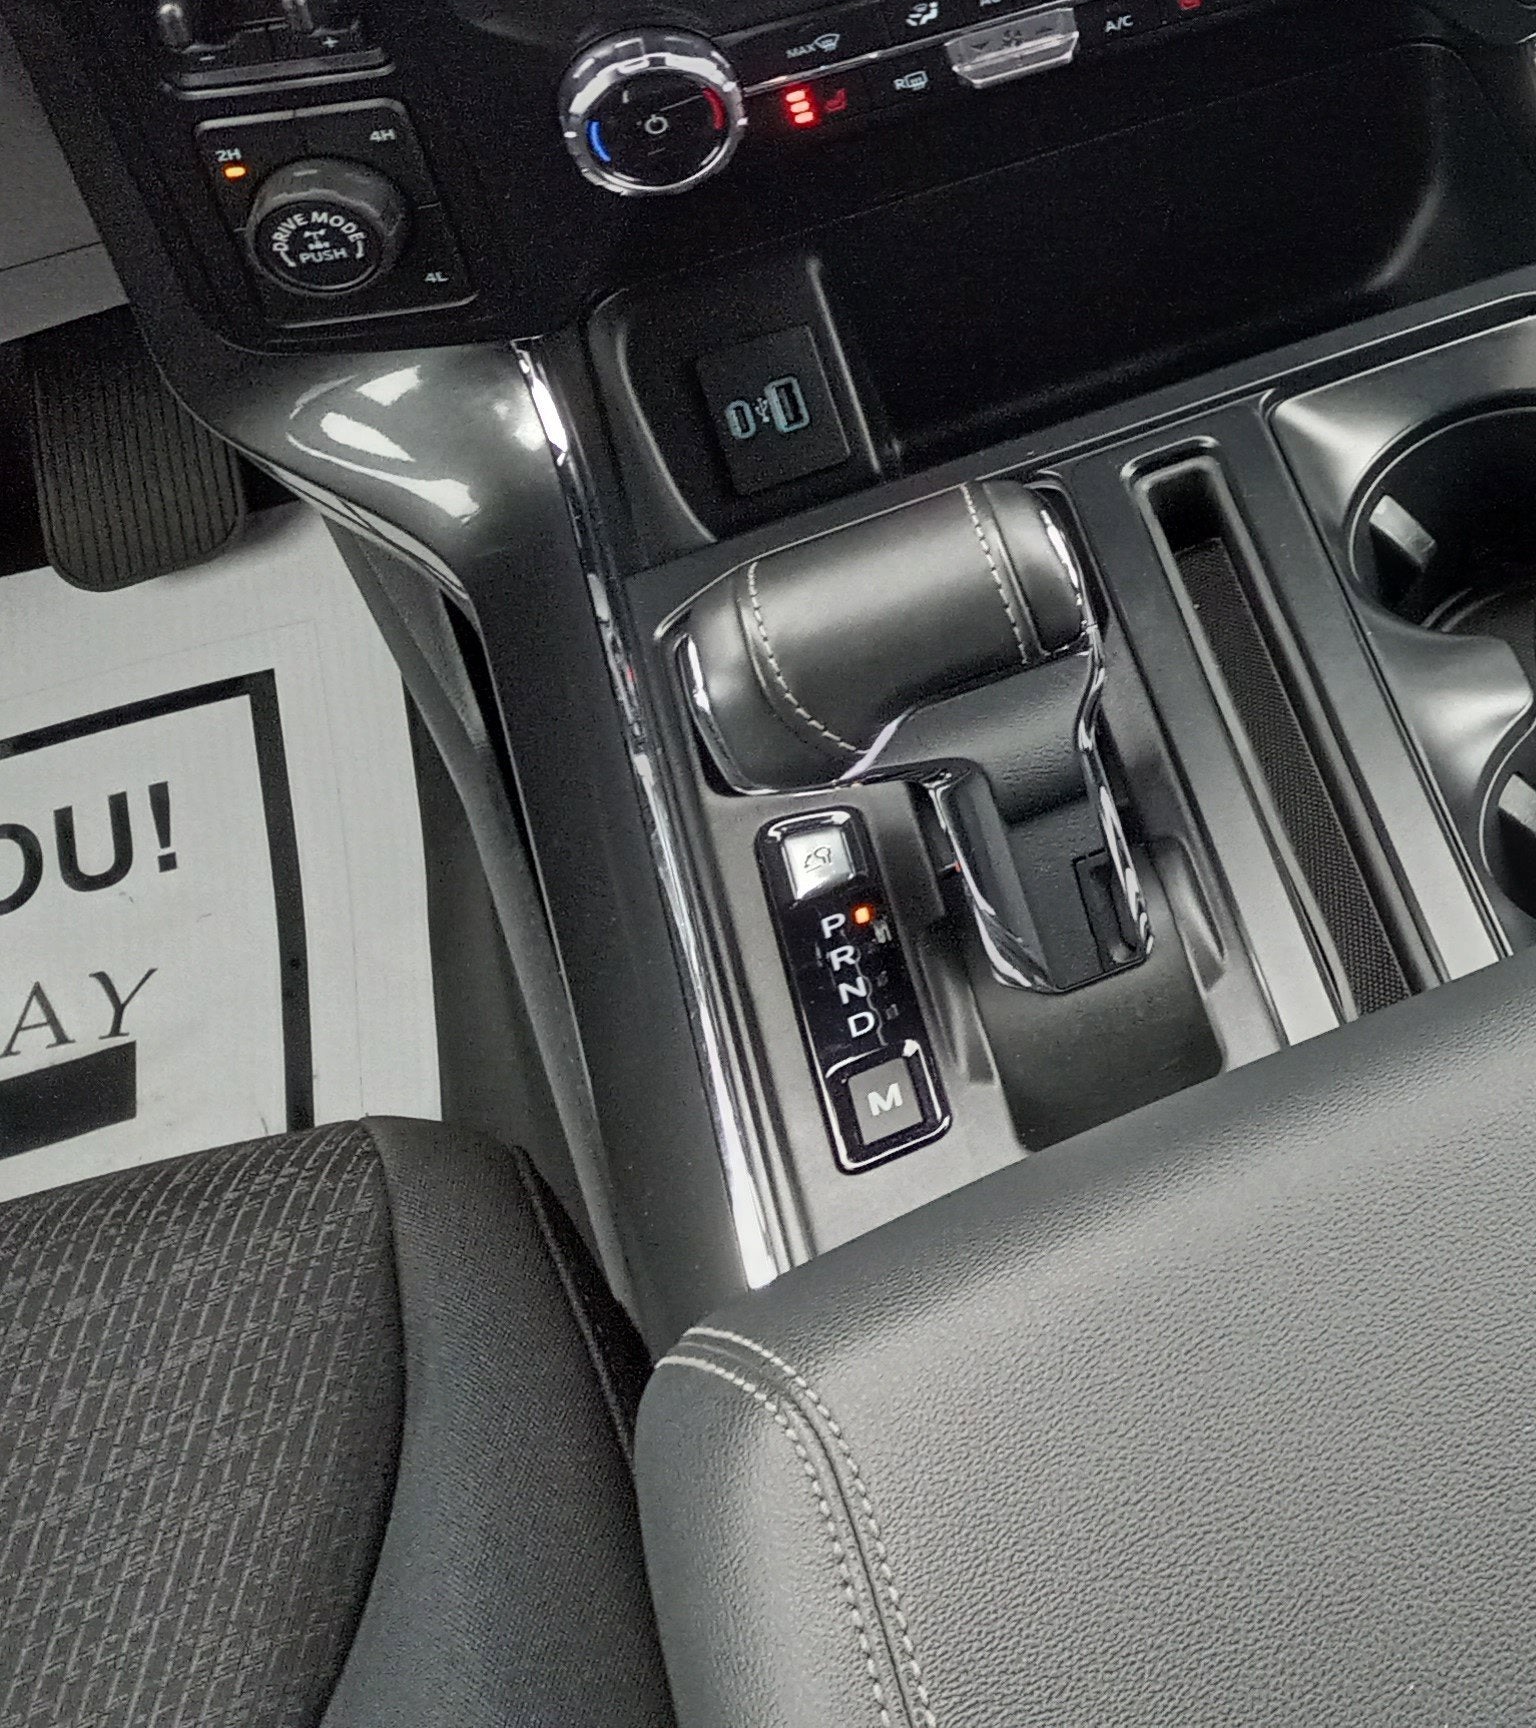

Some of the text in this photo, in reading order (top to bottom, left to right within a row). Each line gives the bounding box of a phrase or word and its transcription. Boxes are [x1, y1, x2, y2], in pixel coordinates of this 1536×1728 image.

[1104, 14, 1134, 34] A/C
[785, 42, 816, 59] MAX
[369, 128, 397, 143] 4H
[215, 147, 242, 162] 2H
[272, 209, 368, 254] DRIVE MODE
[299, 247, 349, 265] PUSH
[819, 912, 847, 940] P
[828, 944, 858, 972] R
[838, 977, 868, 1004] N
[846, 1010, 875, 1039] D
[866, 1082, 905, 1117] M
